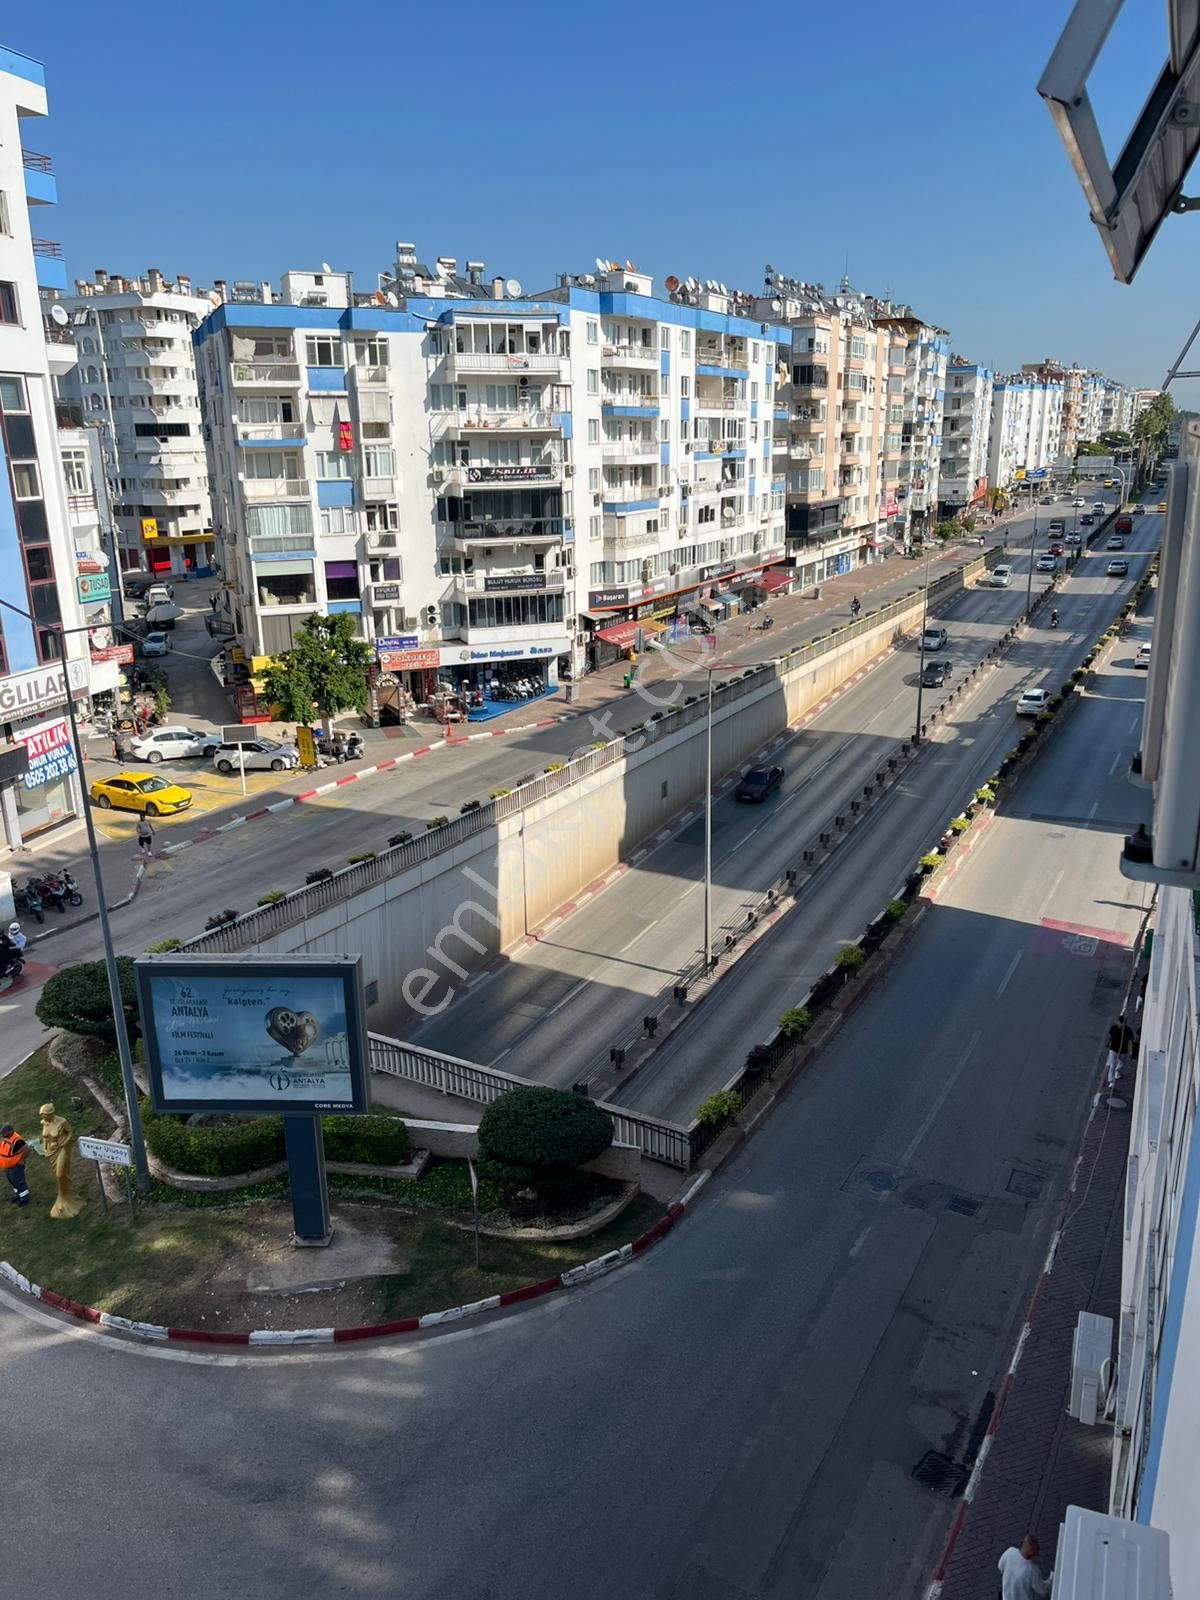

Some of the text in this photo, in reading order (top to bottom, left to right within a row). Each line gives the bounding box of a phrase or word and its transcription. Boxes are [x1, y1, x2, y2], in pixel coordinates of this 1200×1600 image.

[19, 724, 68, 758] ATILIK
[28, 754, 47, 770] ONUR
[24, 768, 46, 788] 0505
[44, 761, 60, 780] 202
[172, 1006, 209, 1018] ANTALYA
